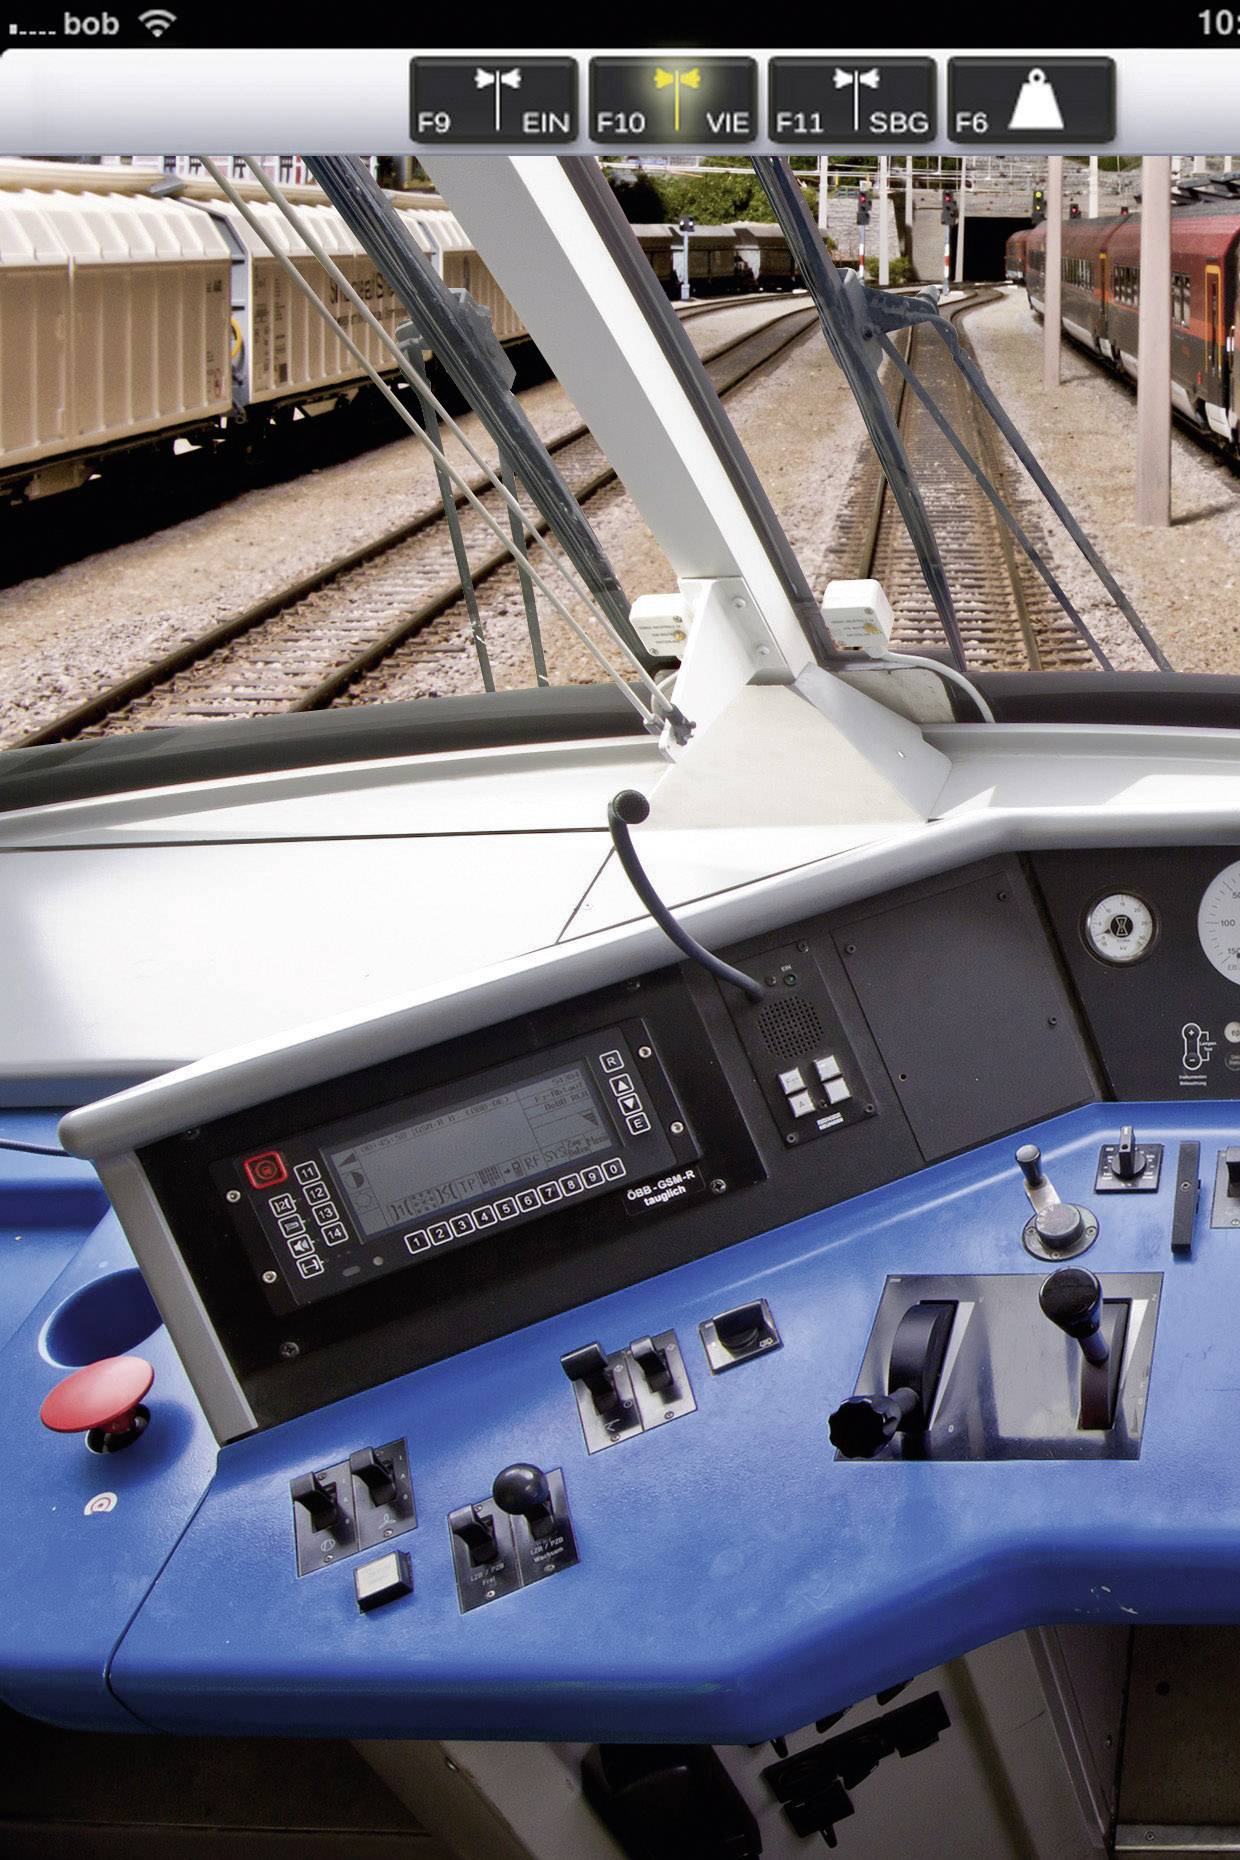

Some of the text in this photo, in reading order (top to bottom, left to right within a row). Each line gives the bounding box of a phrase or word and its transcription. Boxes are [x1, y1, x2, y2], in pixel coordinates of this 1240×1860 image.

[607, 1056, 617, 1067] R
[634, 1119, 643, 1129] E
[301, 1168, 314, 1178] 11
[609, 1164, 617, 1174] 0
[588, 1172, 596, 1182] 9
[567, 1180, 575, 1190] 8
[310, 1188, 323, 1199] 12
[546, 1188, 552, 1198] 7
[643, 1185, 687, 1207] tauglich
[524, 1196, 532, 1206] 6
[319, 1208, 333, 1219] 13
[503, 1204, 511, 1214] 5
[480, 1212, 488, 1221] 4
[458, 1220, 466, 1230] 3
[328, 1229, 343, 1240] 14
[436, 1229, 444, 1239] 2
